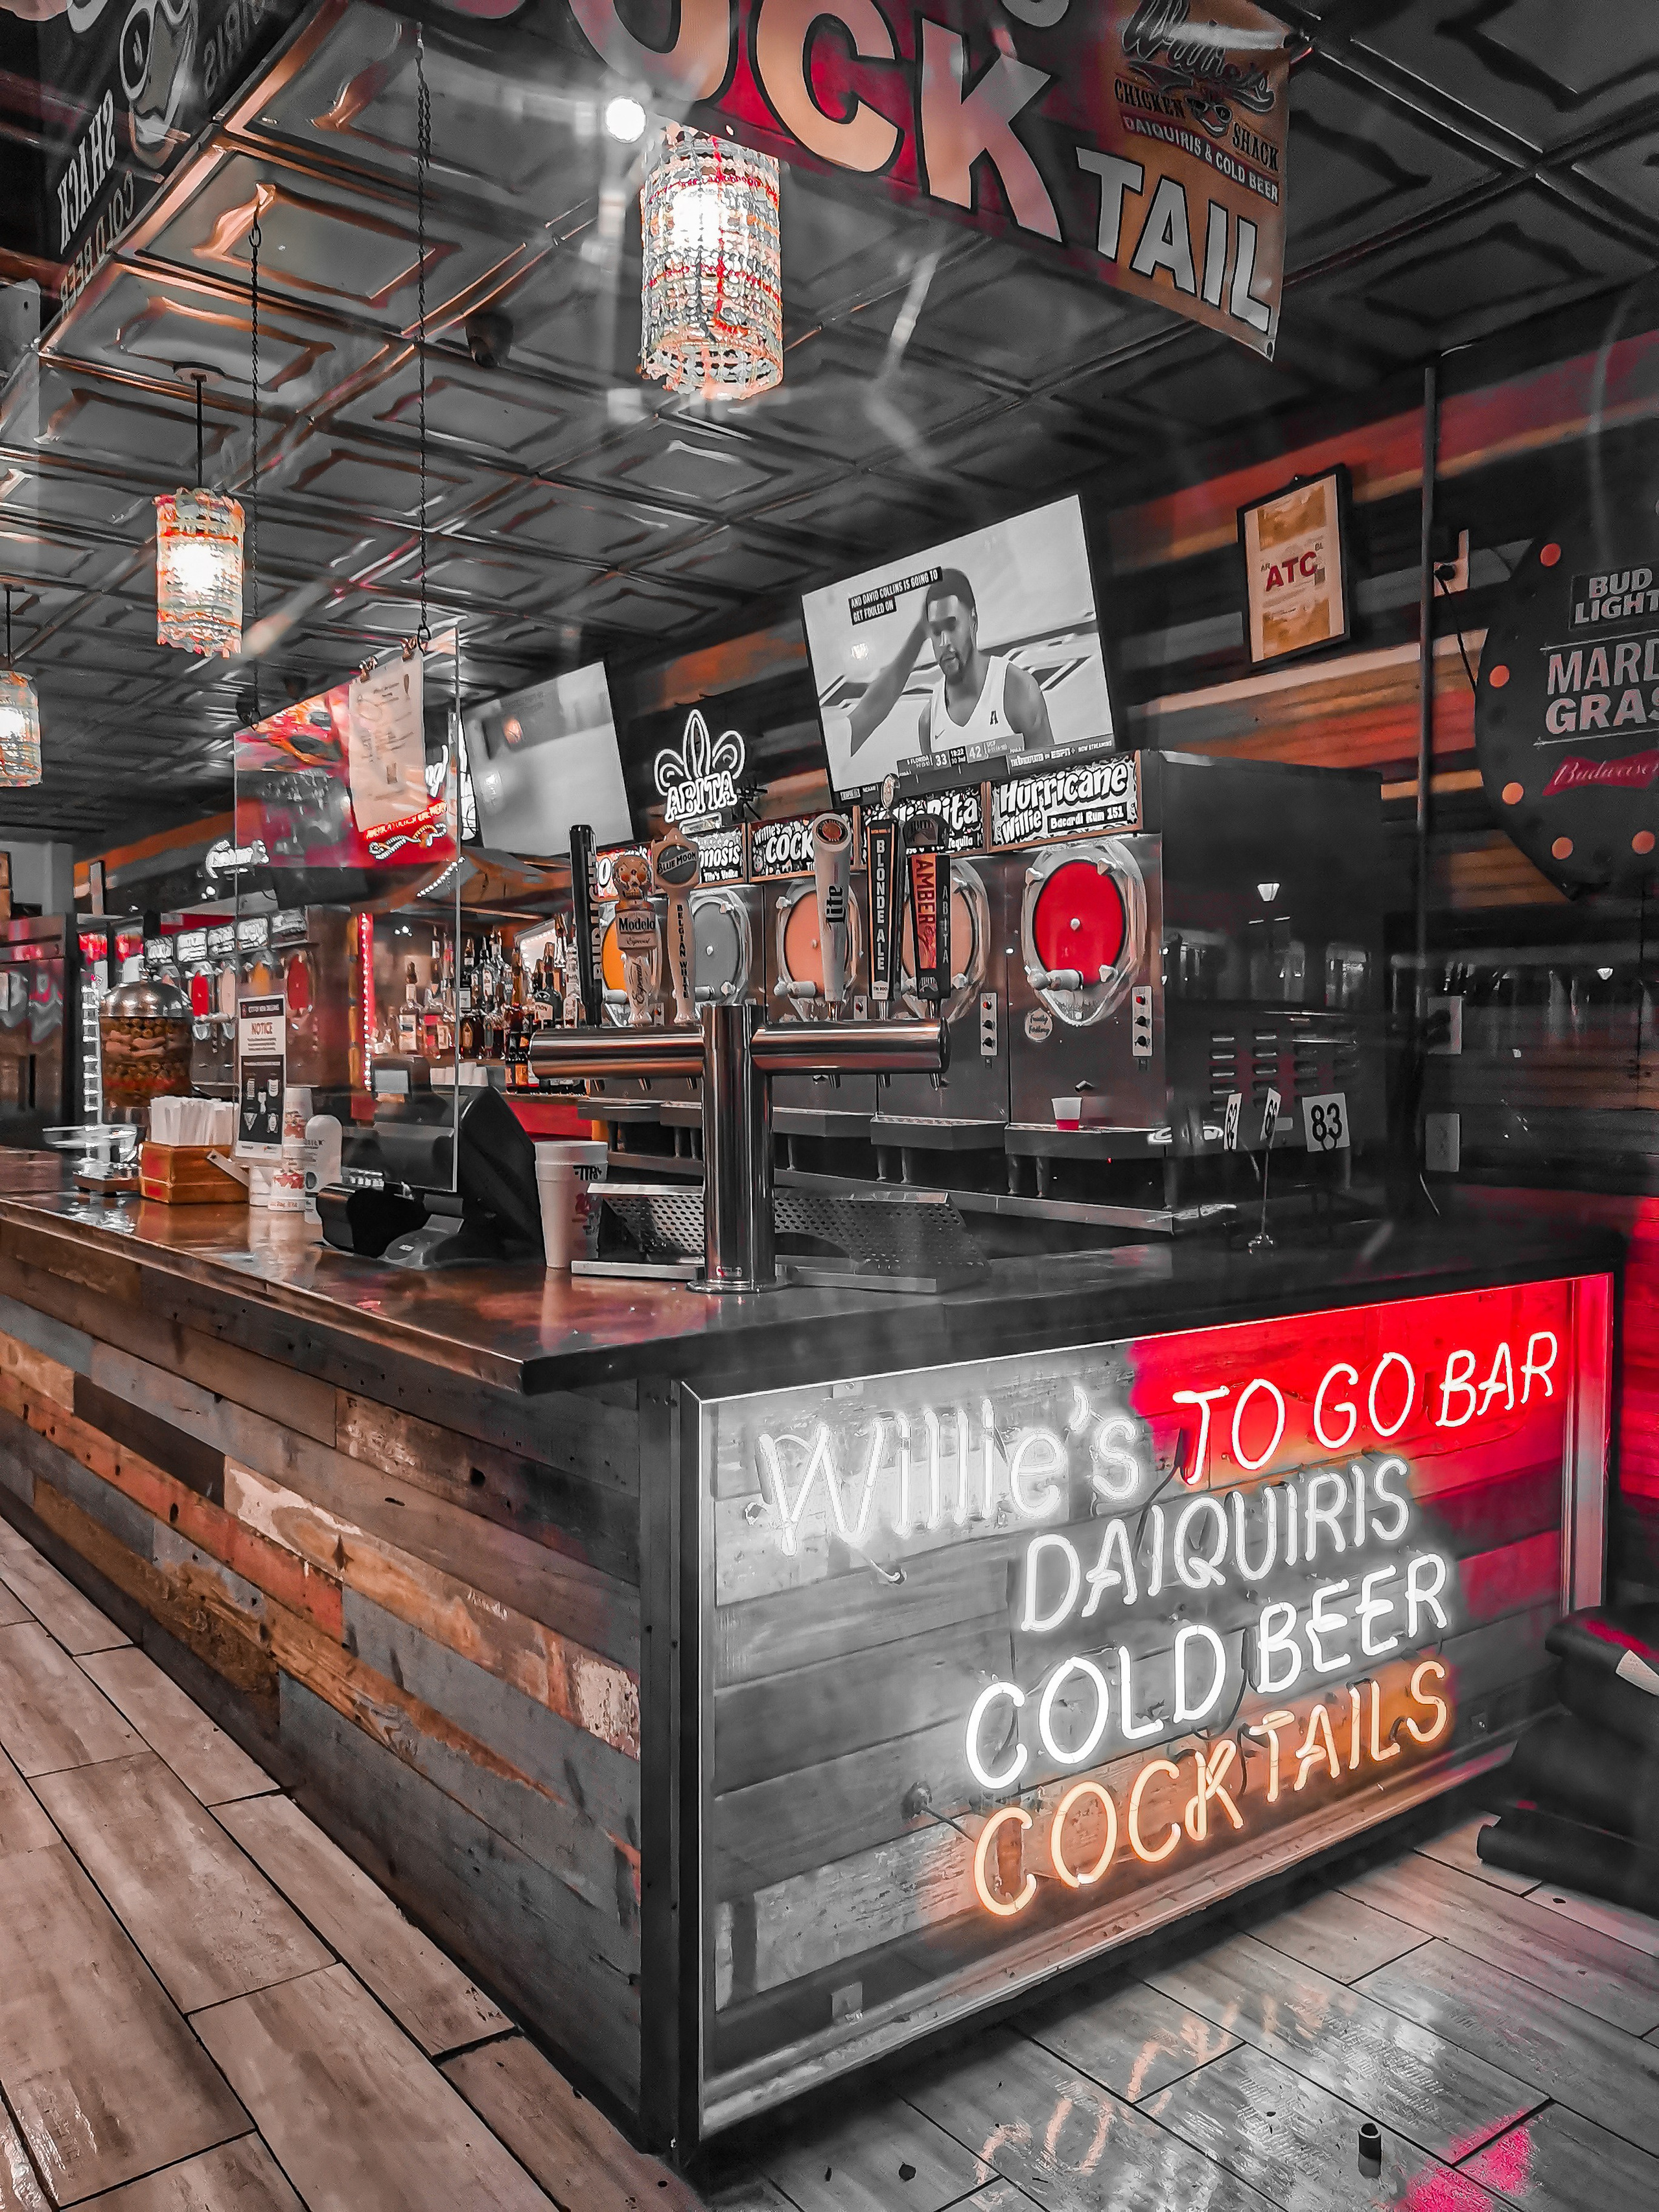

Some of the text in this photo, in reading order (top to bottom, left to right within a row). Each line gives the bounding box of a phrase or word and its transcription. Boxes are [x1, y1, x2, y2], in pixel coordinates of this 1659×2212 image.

[1114, 78, 1279, 172] CHICKEN SHACK
[463, 0, 1063, 243] OCK
[1076, 146, 1271, 335] TAIL
[1123, 115, 1279, 203] DAIQUIRIS & COLD BEER
[851, 569, 938, 609] AND DAVID COLLINS IS GOING TO
[1265, 551, 1318, 592] ATC
[1589, 568, 1653, 599] BUD
[853, 600, 894, 622] GET FOULED ON
[1575, 589, 1659, 623] LIGHT
[935, 753, 947, 767] 33
[969, 745, 983, 759] 42
[1000, 763, 1128, 813] Hurricane
[754, 822, 781, 846] Willie's
[1003, 810, 1042, 843] Willie
[1050, 806, 1124, 830] Bacardi Rum 151
[657, 851, 697, 875] BLUE MOON
[876, 839, 886, 924] BLONDE
[915, 858, 936, 924] AMBER
[618, 917, 656, 931] Modelo
[676, 904, 687, 958] BELGIAN
[876, 928, 886, 971] ALE
[251, 1021, 273, 1036] NOTICE
[1311, 1102, 1342, 1142] 83
[757, 1331, 1559, 1558] Willie's TO GO BAR
[1021, 1456, 1411, 1633] DAIQUIRIS
[965, 1552, 1448, 1791] COLD BEER
[973, 1659, 1450, 1918] COCKTAILS
